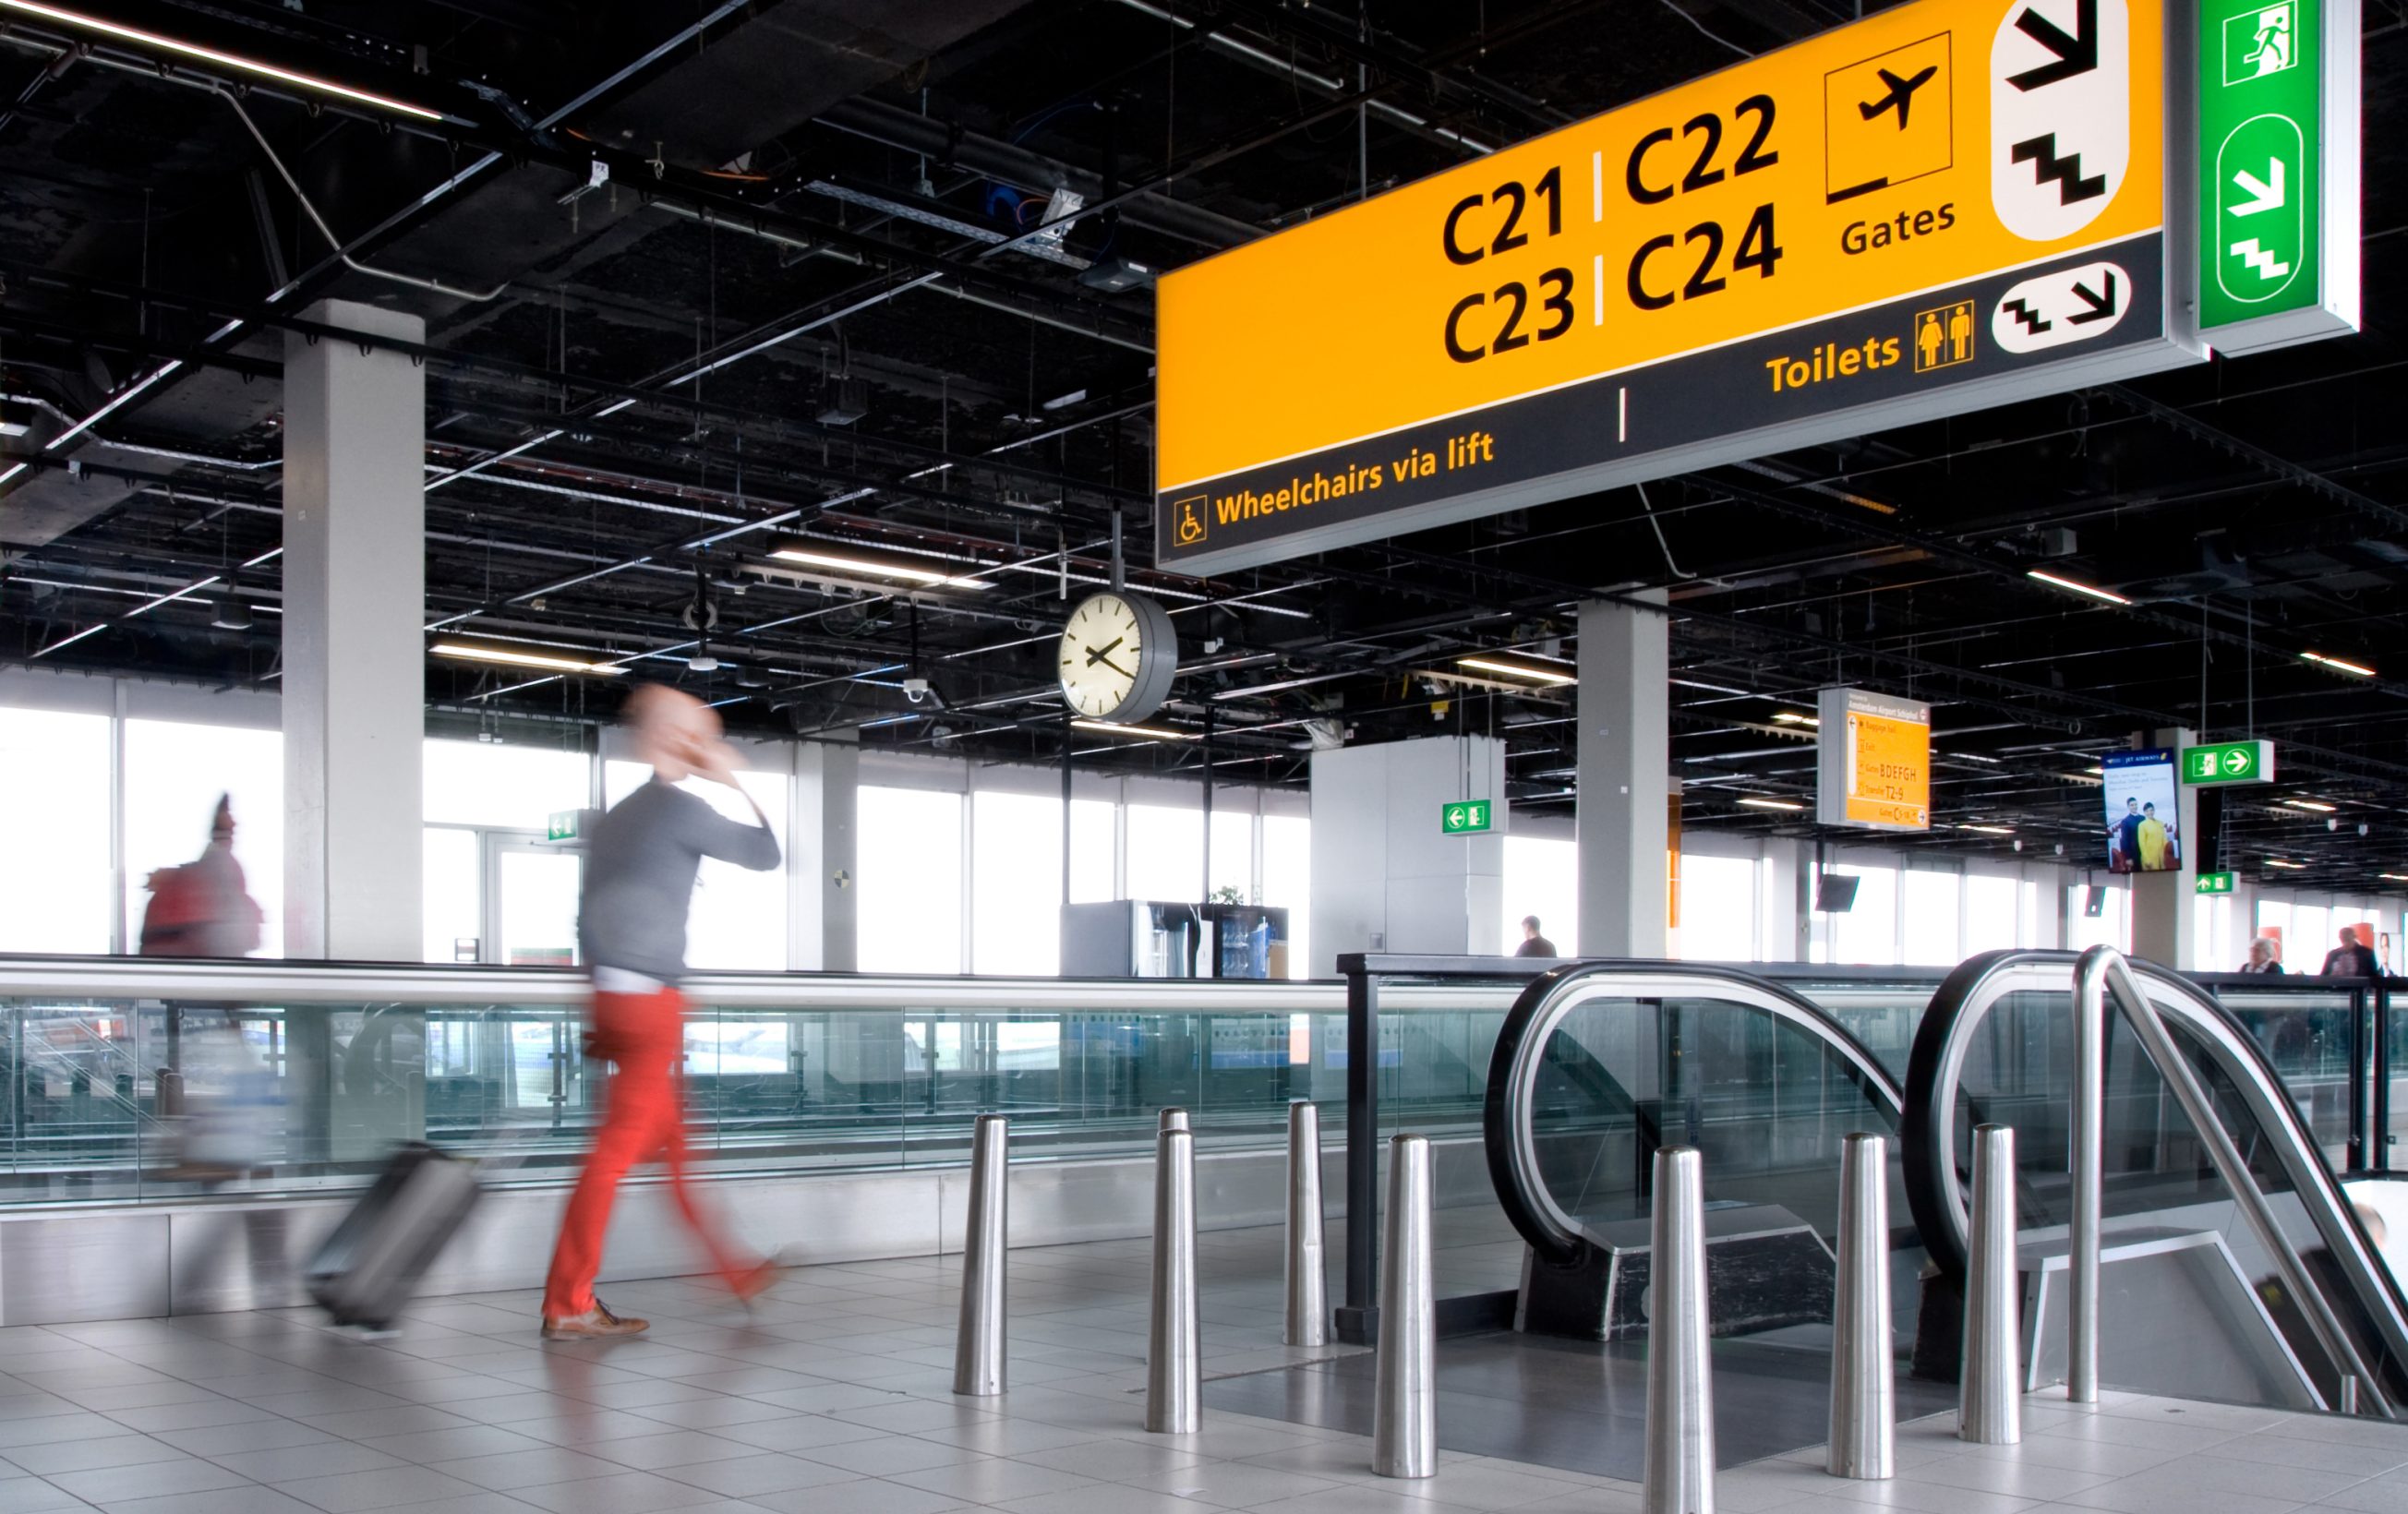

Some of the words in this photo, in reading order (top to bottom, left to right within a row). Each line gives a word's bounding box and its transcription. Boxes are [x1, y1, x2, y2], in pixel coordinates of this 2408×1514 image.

[1443, 165, 1562, 266] C21
[1625, 93, 1778, 205] C22
[1840, 201, 1956, 256] Gates
[1443, 267, 1575, 365] C23
[1626, 202, 1783, 311] C24
[1765, 334, 1901, 392] Toilets
[1216, 463, 1383, 525] Wheelchairs
[1392, 448, 1437, 483] via
[1448, 431, 1494, 471] lift
[1885, 785, 1904, 801] T2-9
